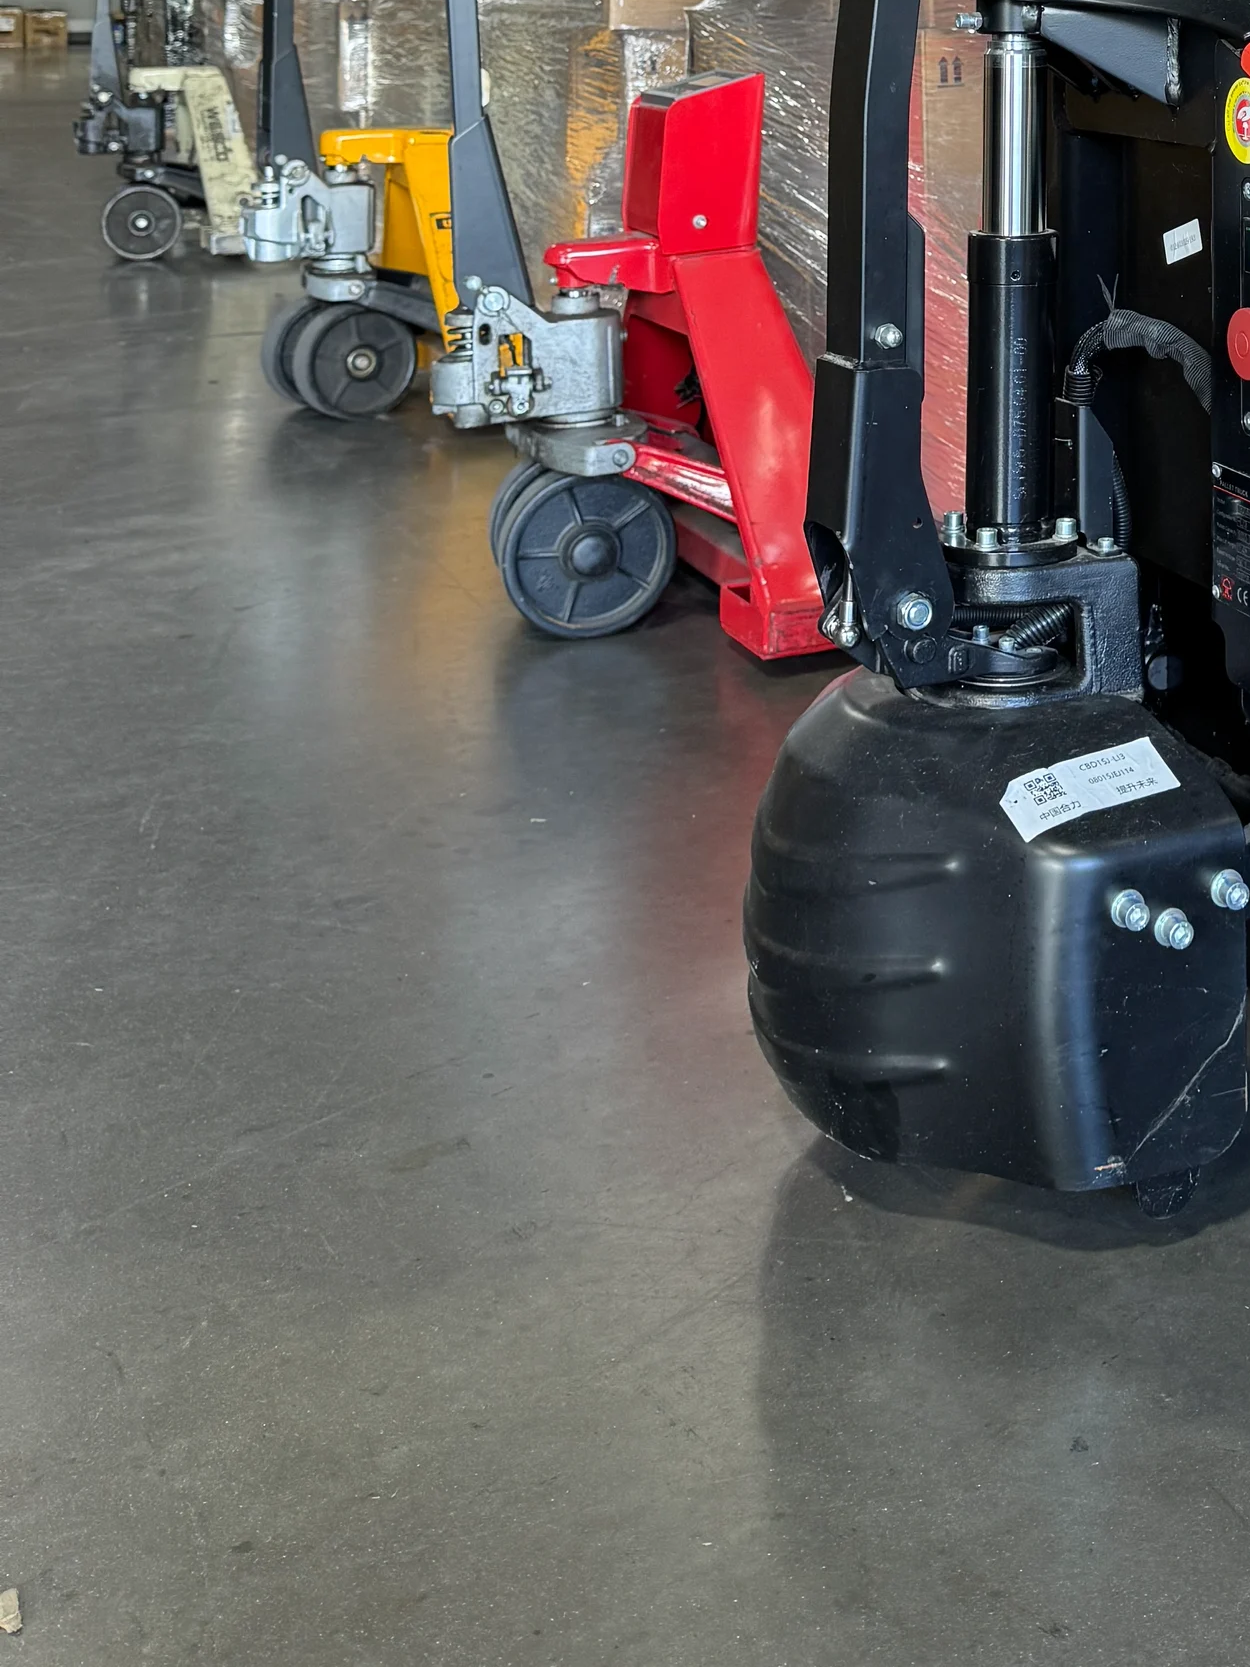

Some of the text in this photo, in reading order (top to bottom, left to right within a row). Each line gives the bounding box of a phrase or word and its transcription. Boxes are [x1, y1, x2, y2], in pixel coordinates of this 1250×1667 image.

[1078, 752, 1126, 772] CBD15J-LI3
[1116, 777, 1158, 795] 提升未来
[1039, 800, 1082, 821] 中国合力
